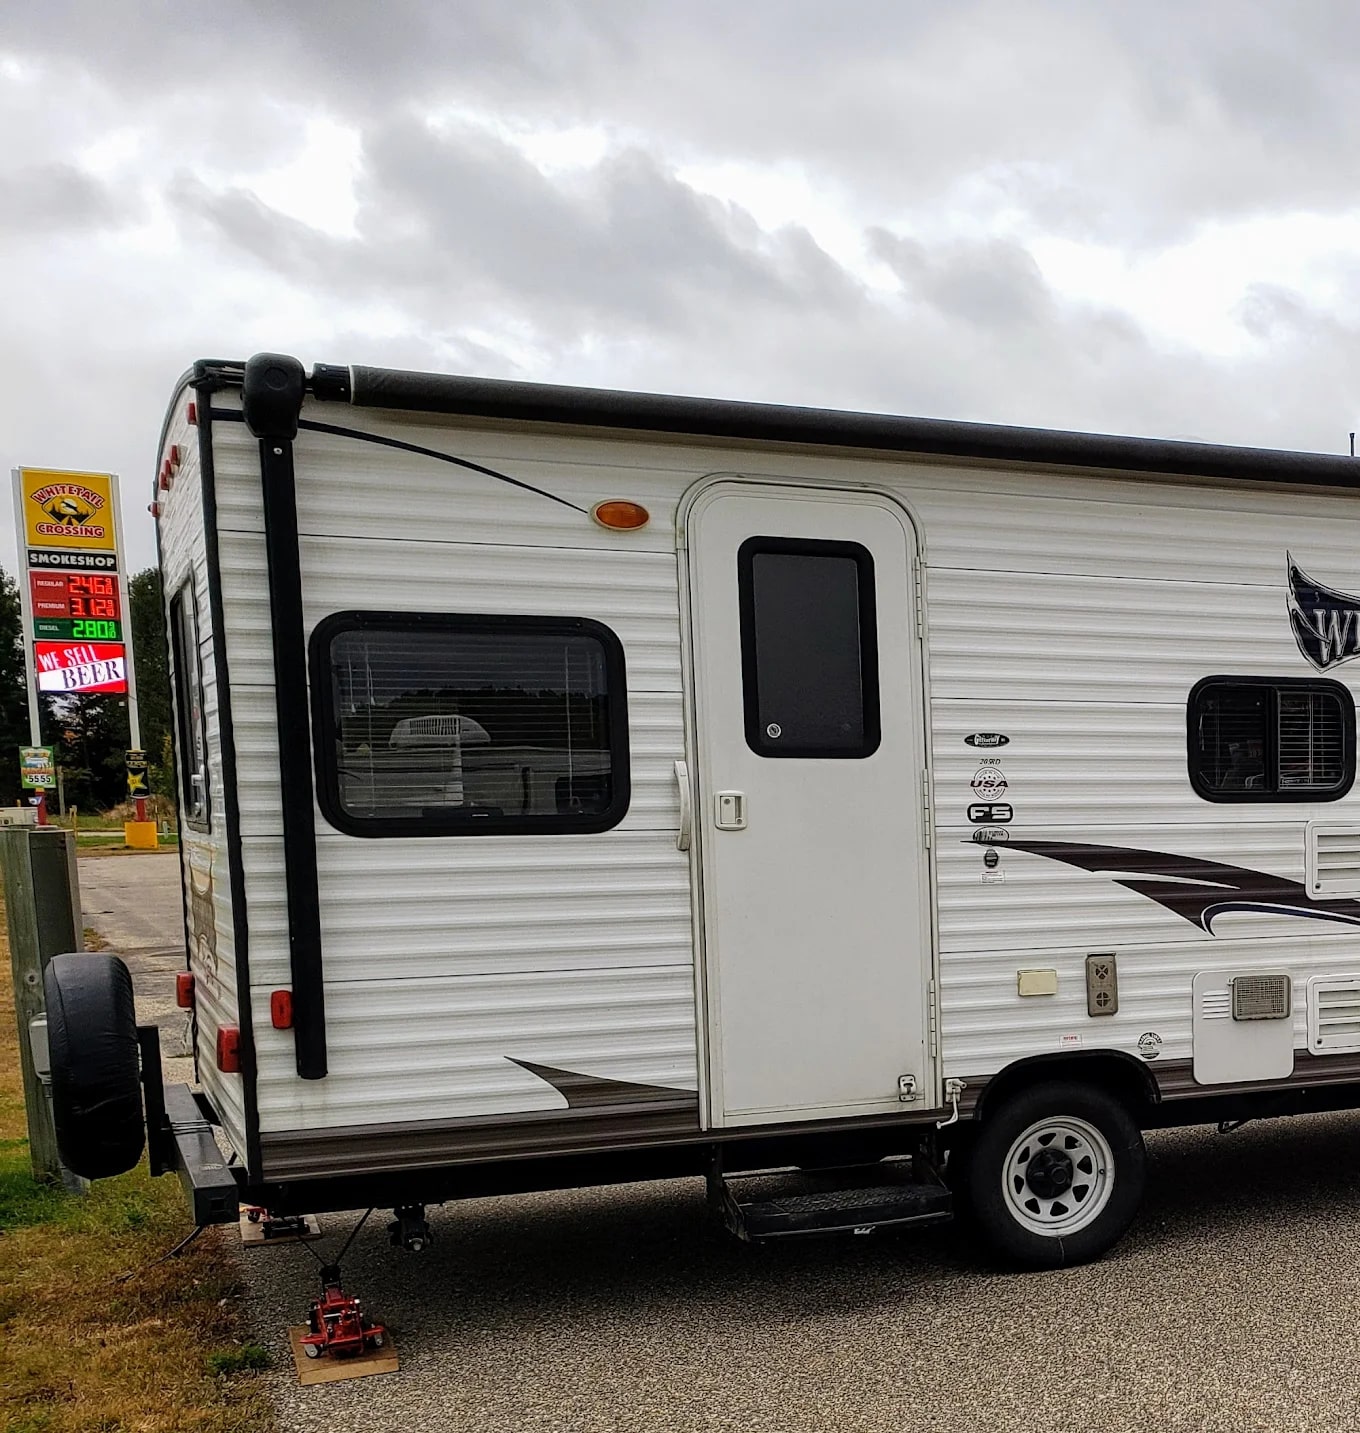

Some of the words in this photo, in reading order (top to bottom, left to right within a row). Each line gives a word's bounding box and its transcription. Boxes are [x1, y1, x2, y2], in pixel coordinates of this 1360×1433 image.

[31, 484, 104, 509] WHITETAIL
[37, 523, 104, 537] CROSSING
[30, 553, 115, 567] SMOKESHOP
[38, 651, 61, 672] WE
[63, 644, 99, 667] SELL
[62, 660, 122, 689] BEER
[970, 780, 1009, 788] USA
[970, 806, 1011, 820] FS
